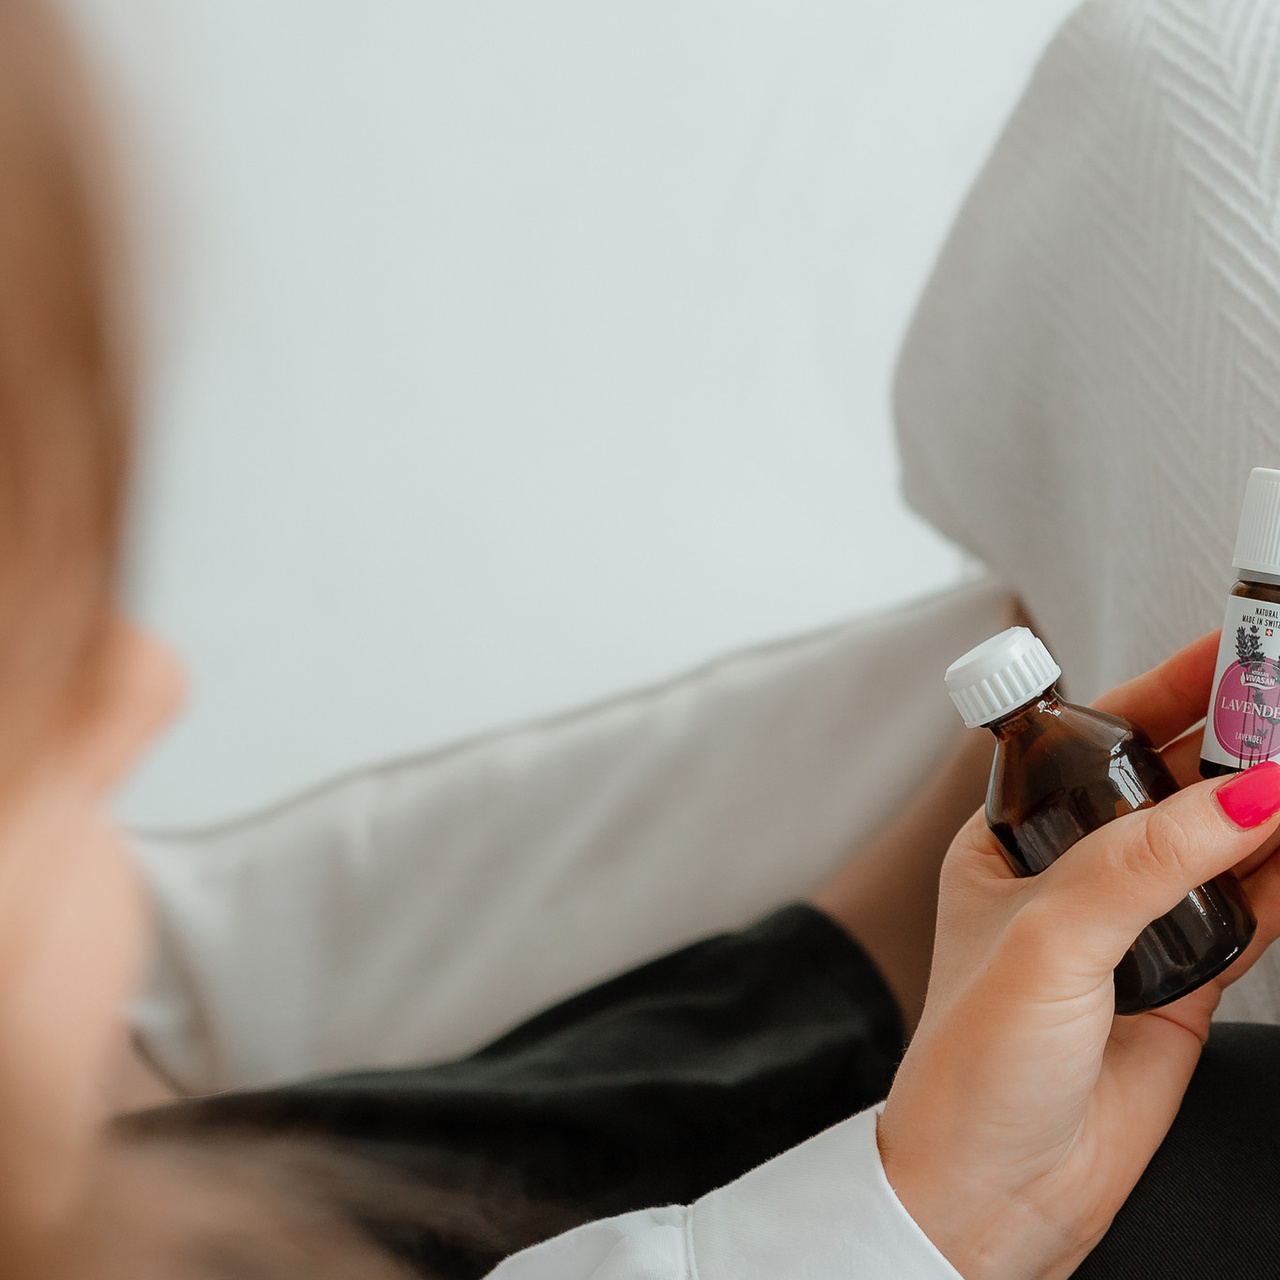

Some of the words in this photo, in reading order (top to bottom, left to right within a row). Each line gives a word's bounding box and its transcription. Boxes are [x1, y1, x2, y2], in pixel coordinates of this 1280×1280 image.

[1255, 607, 1279, 619] NATURAL
[1242, 614, 1256, 624] MADE
[1256, 617, 1263, 625] IN
[1245, 673, 1275, 686] VIVASAN
[1235, 731, 1263, 745] LAVENDEL
